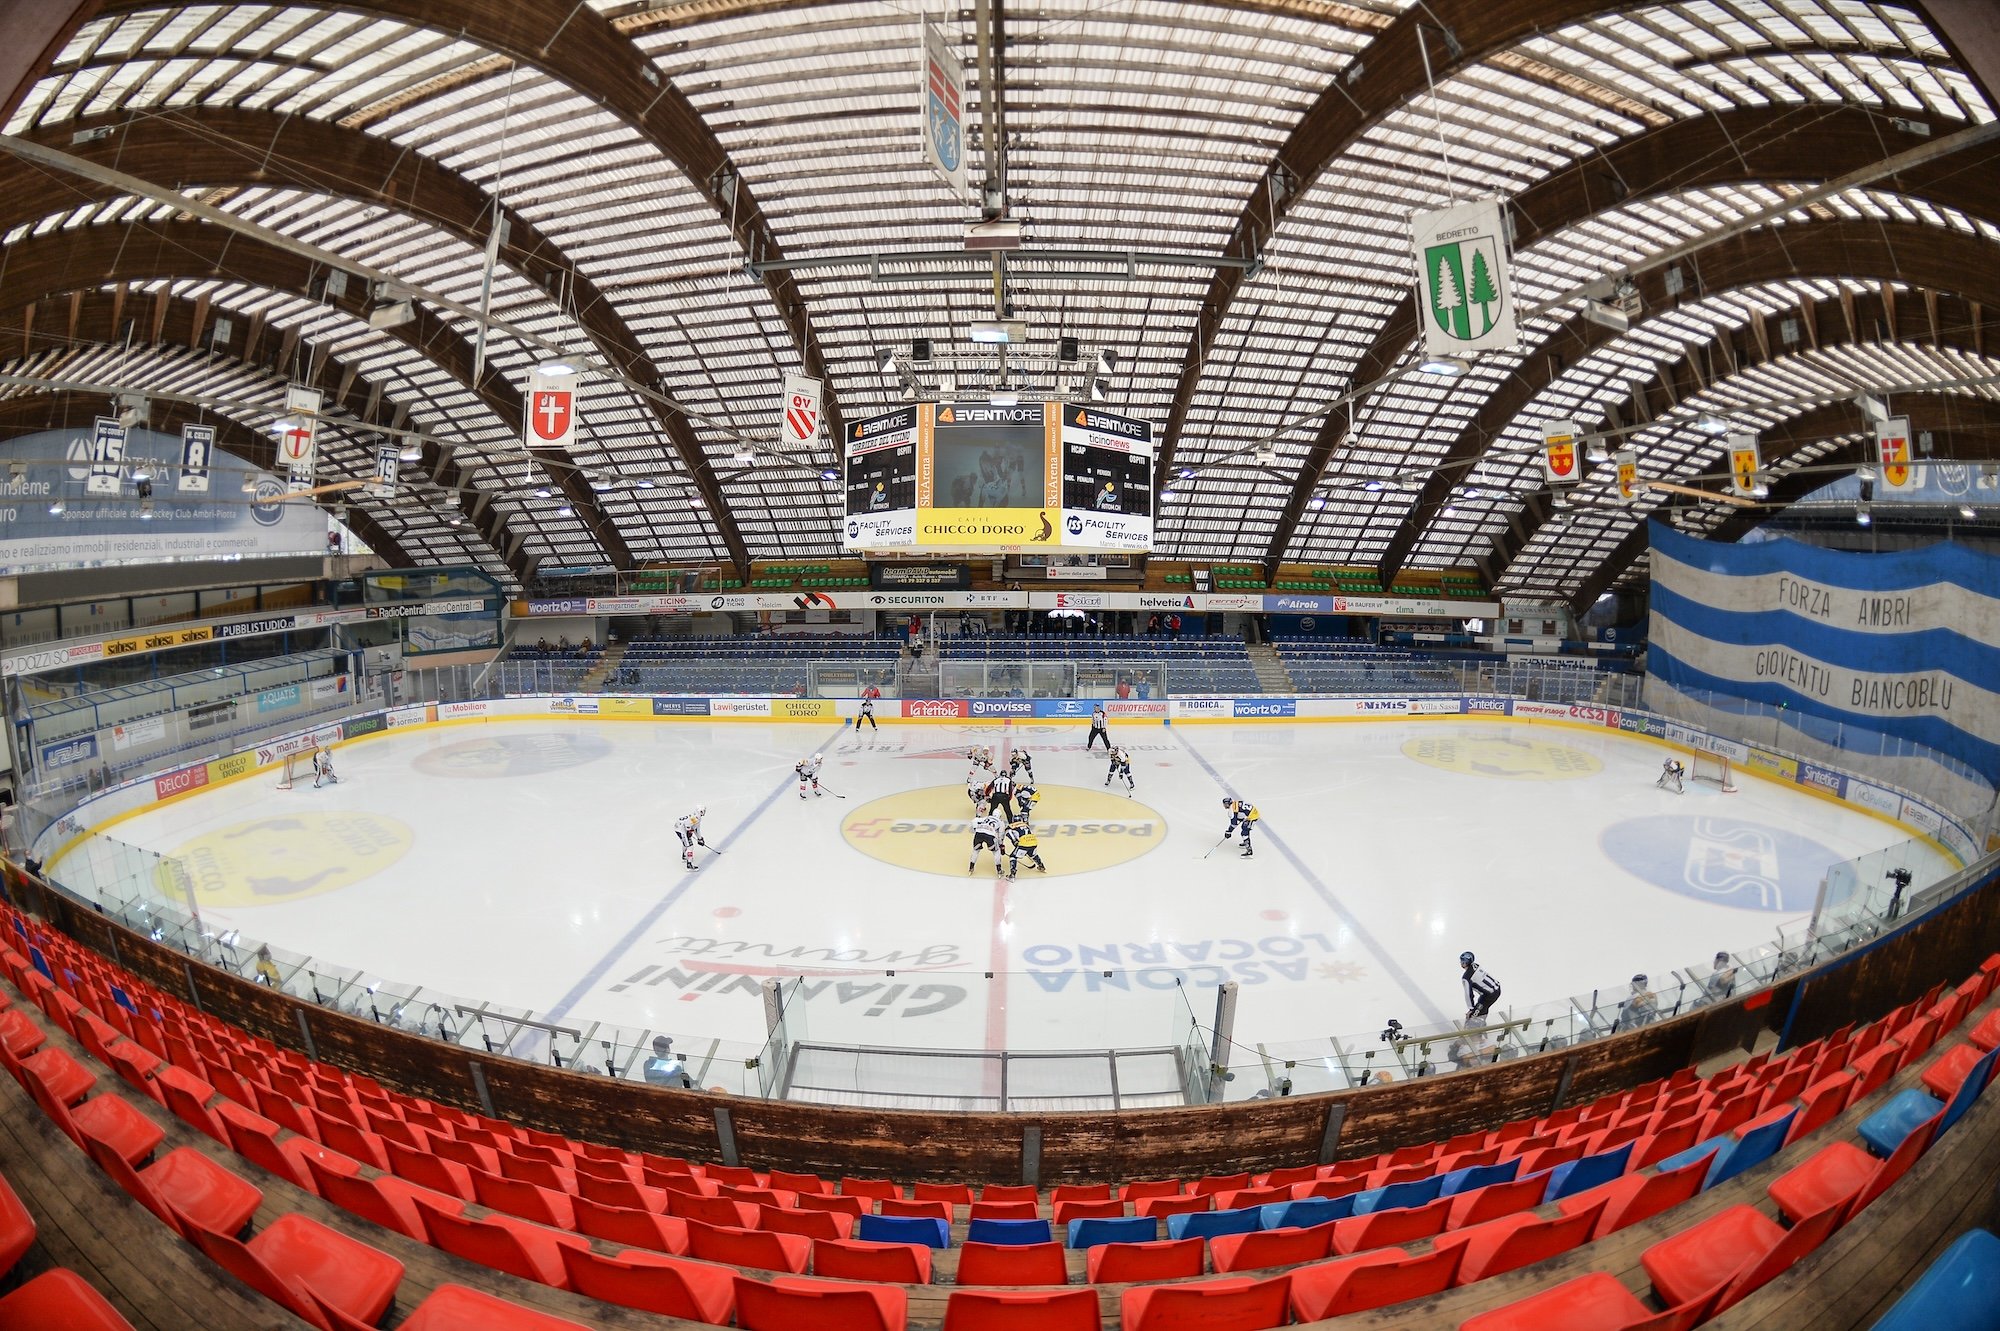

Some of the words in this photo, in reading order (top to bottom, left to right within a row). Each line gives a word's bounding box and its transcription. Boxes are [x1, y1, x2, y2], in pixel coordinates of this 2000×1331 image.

[1436, 226, 1479, 241] BEDRETTO
[956, 409, 1041, 421] EVENTMORE
[863, 414, 908, 435] EVENTMORE
[1087, 415, 1142, 437] EVENTMORE
[1089, 434, 1130, 449] ticinonews
[94, 438, 122, 473] 15
[1071, 445, 1086, 454] HCAP
[188, 441, 204, 474] 8
[919, 457, 931, 507] SkiArena
[1047, 457, 1058, 507] SkiArena
[96, 508, 127, 518] ufficiale
[175, 509, 190, 518] Club
[859, 520, 891, 530] FACILITY
[924, 525, 977, 534] CHICCO
[982, 525, 1025, 534] D'ORO
[1085, 520, 1126, 529] FACILITY
[876, 527, 912, 536] SERVICES
[1105, 531, 1148, 541] SERVICES
[21, 543, 70, 557] realizziamo
[73, 540, 111, 553] immobili
[165, 538, 204, 550] industriali
[213, 537, 259, 548] commerciali
[888, 596, 944, 604] SECURITON
[1140, 598, 1181, 607] helvetia
[1289, 600, 1319, 609] Airolo
[1780, 577, 1831, 619] FORZA
[1858, 597, 1911, 626] AMBRI
[379, 605, 426, 617] RadioCentral
[427, 602, 472, 615] RadioCentral
[529, 602, 560, 613] woertz
[1427, 607, 1446, 615] clima
[262, 687, 296, 704] AQUATIS
[1851, 677, 1953, 711] BIANCOBLU
[452, 703, 487, 713] Mobiliare
[713, 703, 769, 713] Lawilgerüstet.
[911, 704, 921, 715] la
[923, 704, 959, 716] tettoia
[986, 701, 1032, 711] novisse
[1056, 701, 1084, 713] SES
[1107, 704, 1166, 712] CURVOTECNICA
[1187, 701, 1219, 709] ROGICA
[1235, 705, 1270, 715] woertz
[1420, 702, 1438, 711] Villa
[1439, 703, 1459, 711] Sassa
[1468, 698, 1505, 710] Sintetica
[1569, 706, 1605, 720] ecsa
[348, 719, 377, 736] pemsa
[276, 739, 299, 754] manz
[218, 757, 246, 772] CHICCO
[159, 773, 190, 793] DELCO
[1805, 765, 1840, 789] Sintetica
[656, 936, 961, 967] graniti
[1023, 933, 1336, 966] LOCARNO
[1027, 957, 1310, 993] ASCONA
